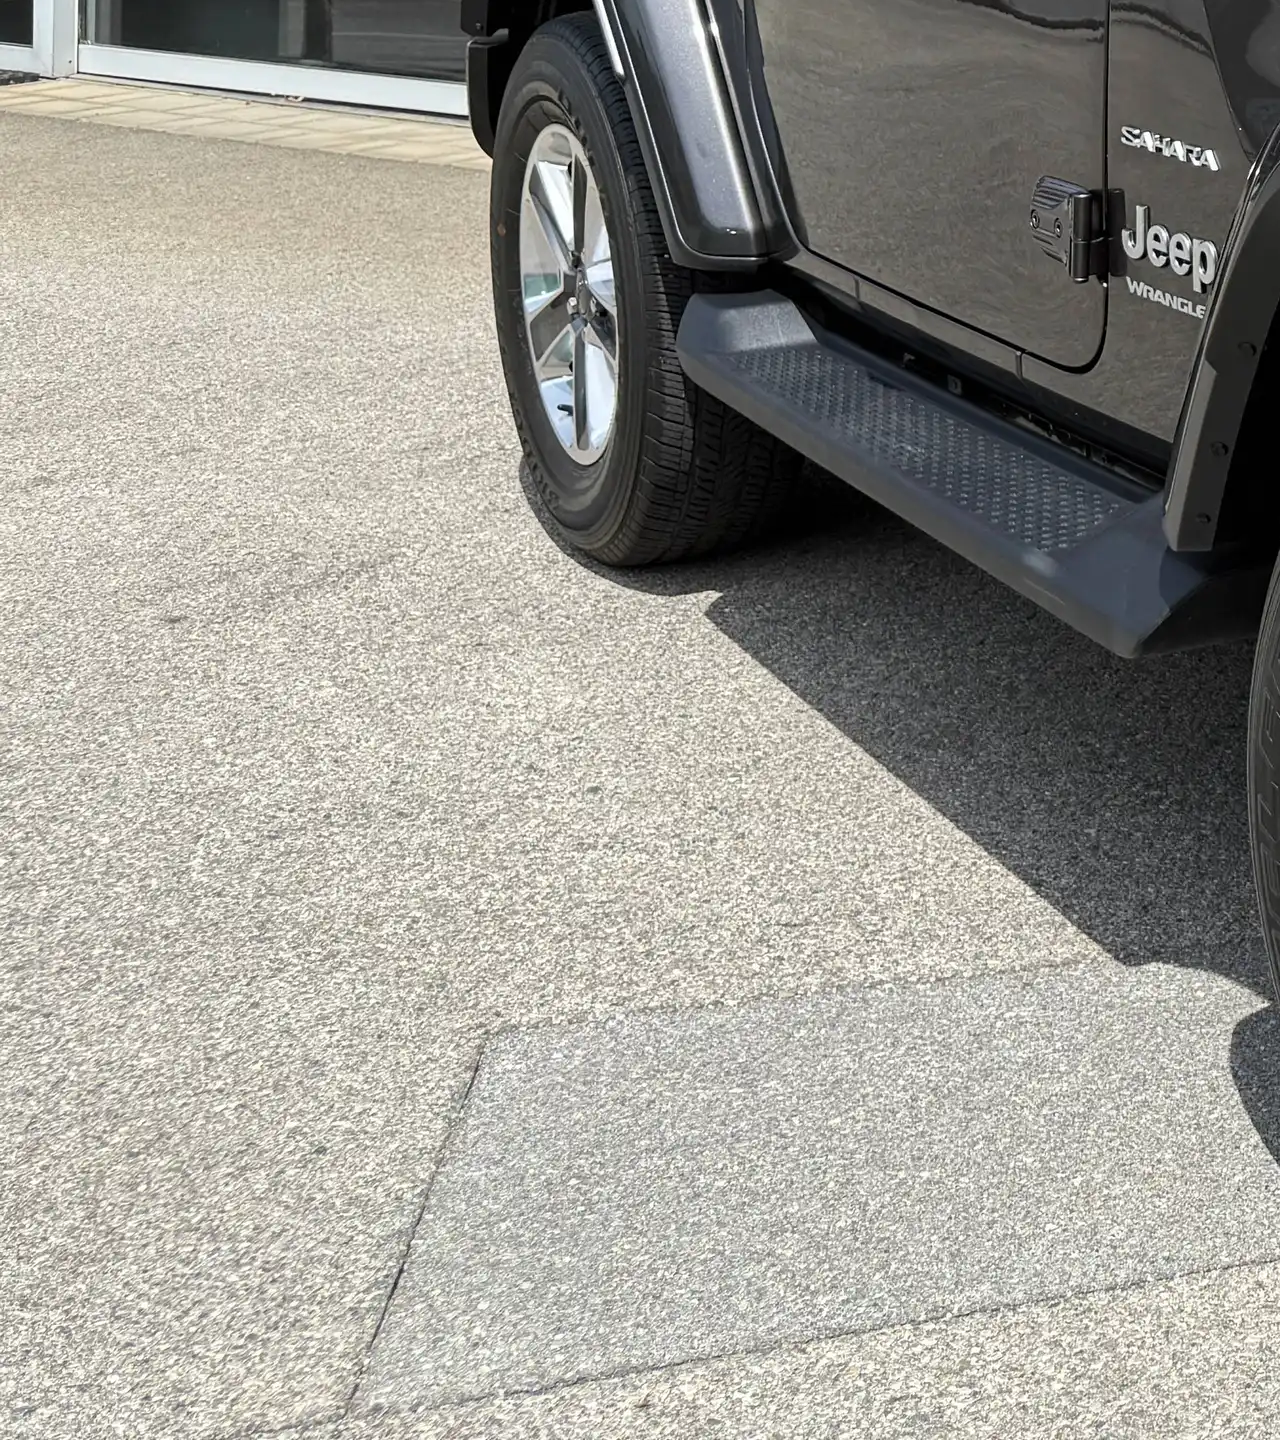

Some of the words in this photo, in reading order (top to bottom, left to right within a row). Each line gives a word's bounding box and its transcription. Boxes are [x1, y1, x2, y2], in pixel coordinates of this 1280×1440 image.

[1121, 125, 1221, 172] SAHARA
[1121, 205, 1219, 294] Jeep
[1125, 275, 1207, 320] WRANGLE
